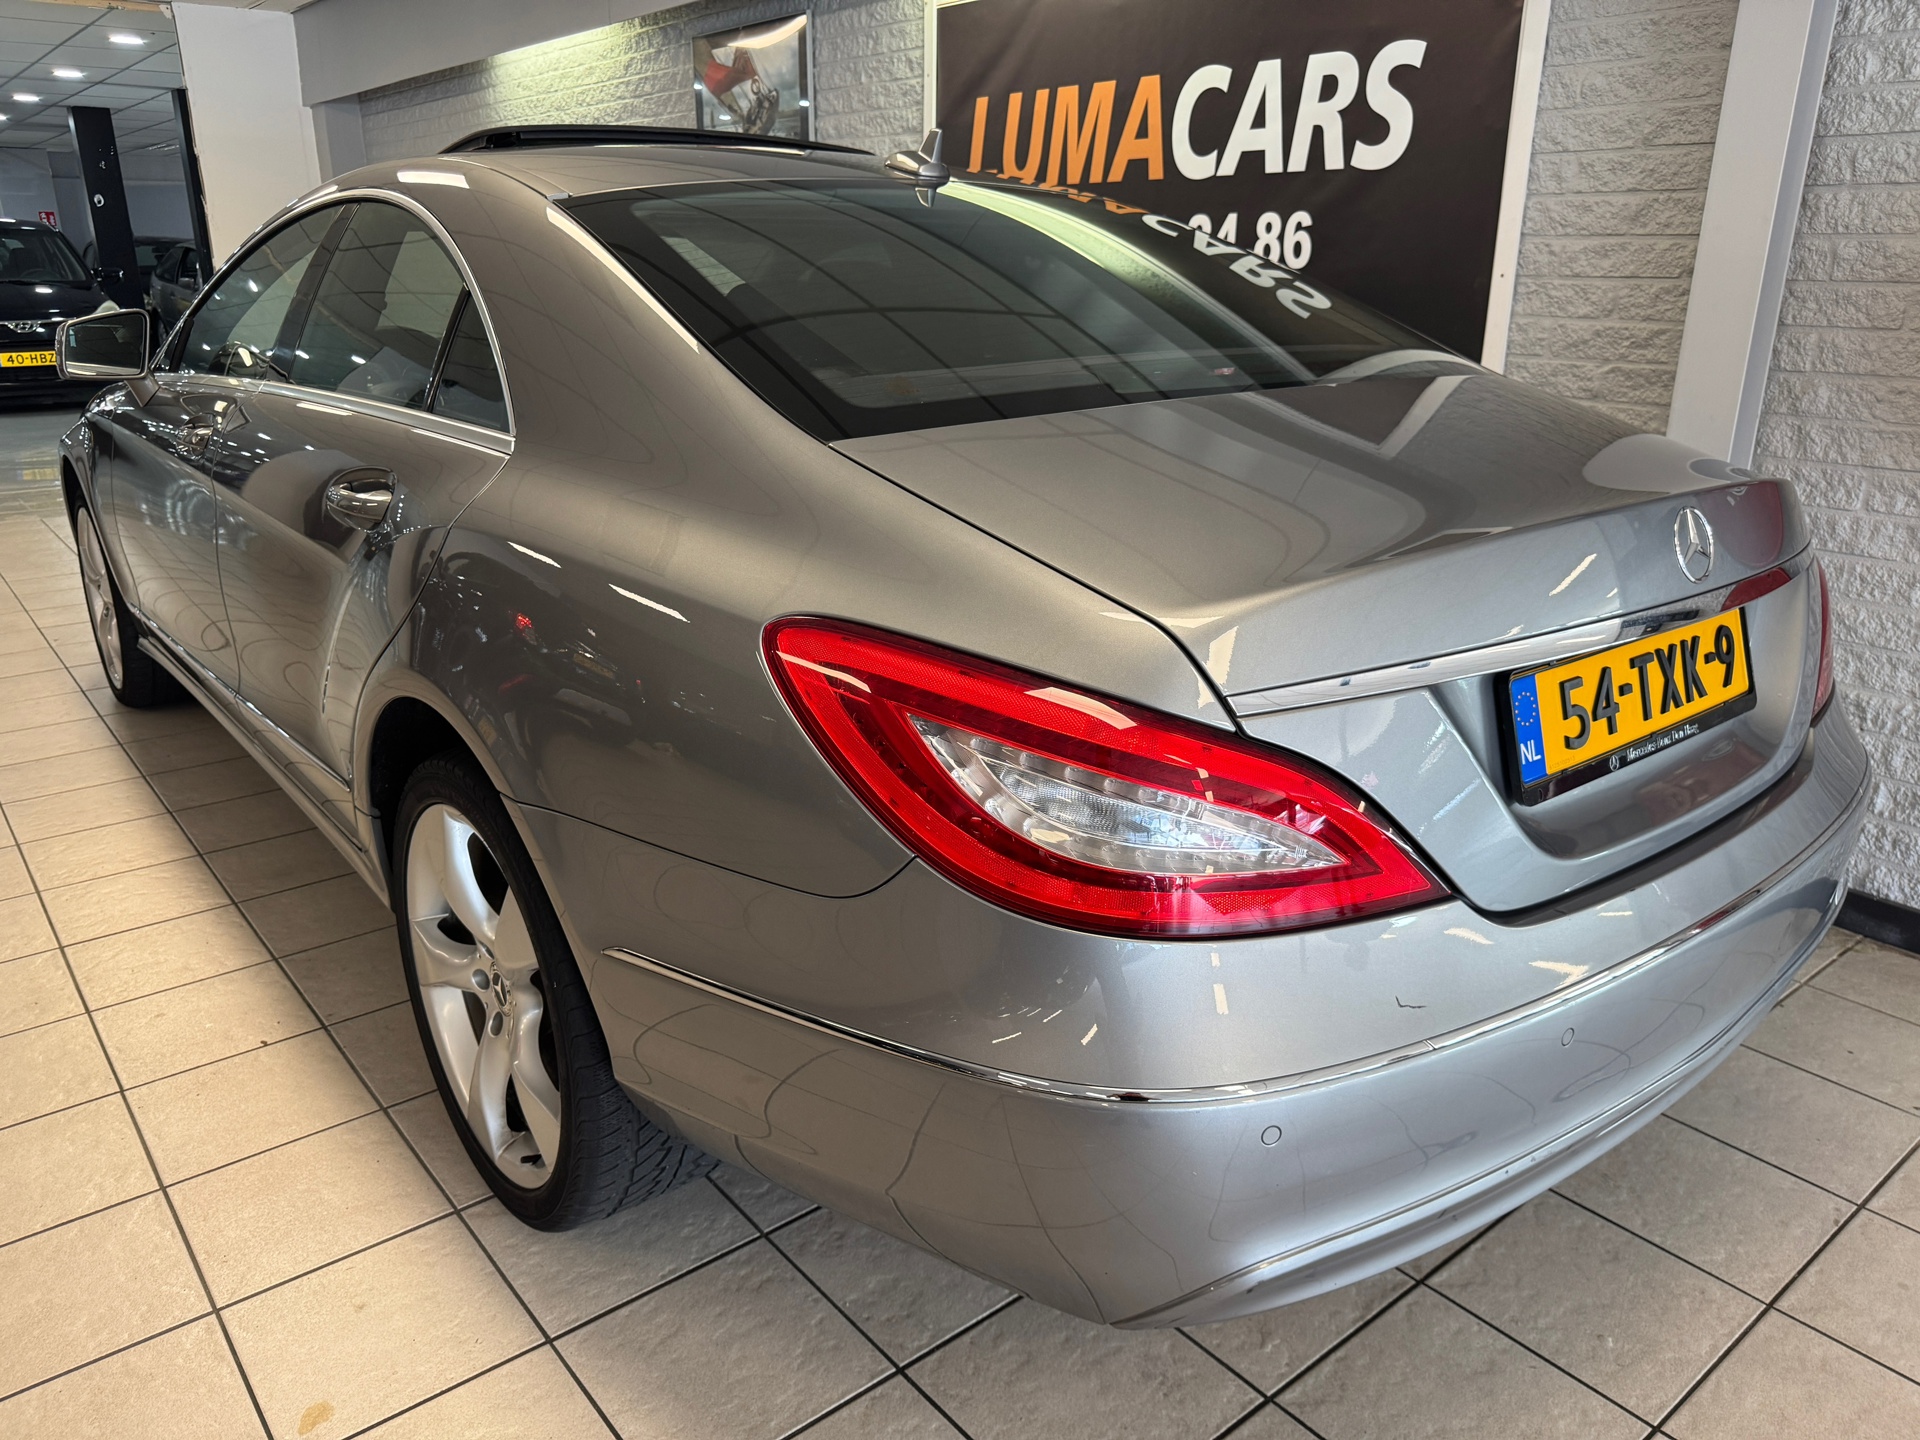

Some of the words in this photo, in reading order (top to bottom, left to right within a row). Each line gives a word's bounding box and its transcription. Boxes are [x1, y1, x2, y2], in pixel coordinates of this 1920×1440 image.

[966, 39, 1427, 186] LUMACARS
[1254, 210, 1313, 270] 86
[7, 353, 57, 365] 40-HBZ
[1558, 624, 1735, 750] 54-TXK-9
[1520, 739, 1542, 765] NL
